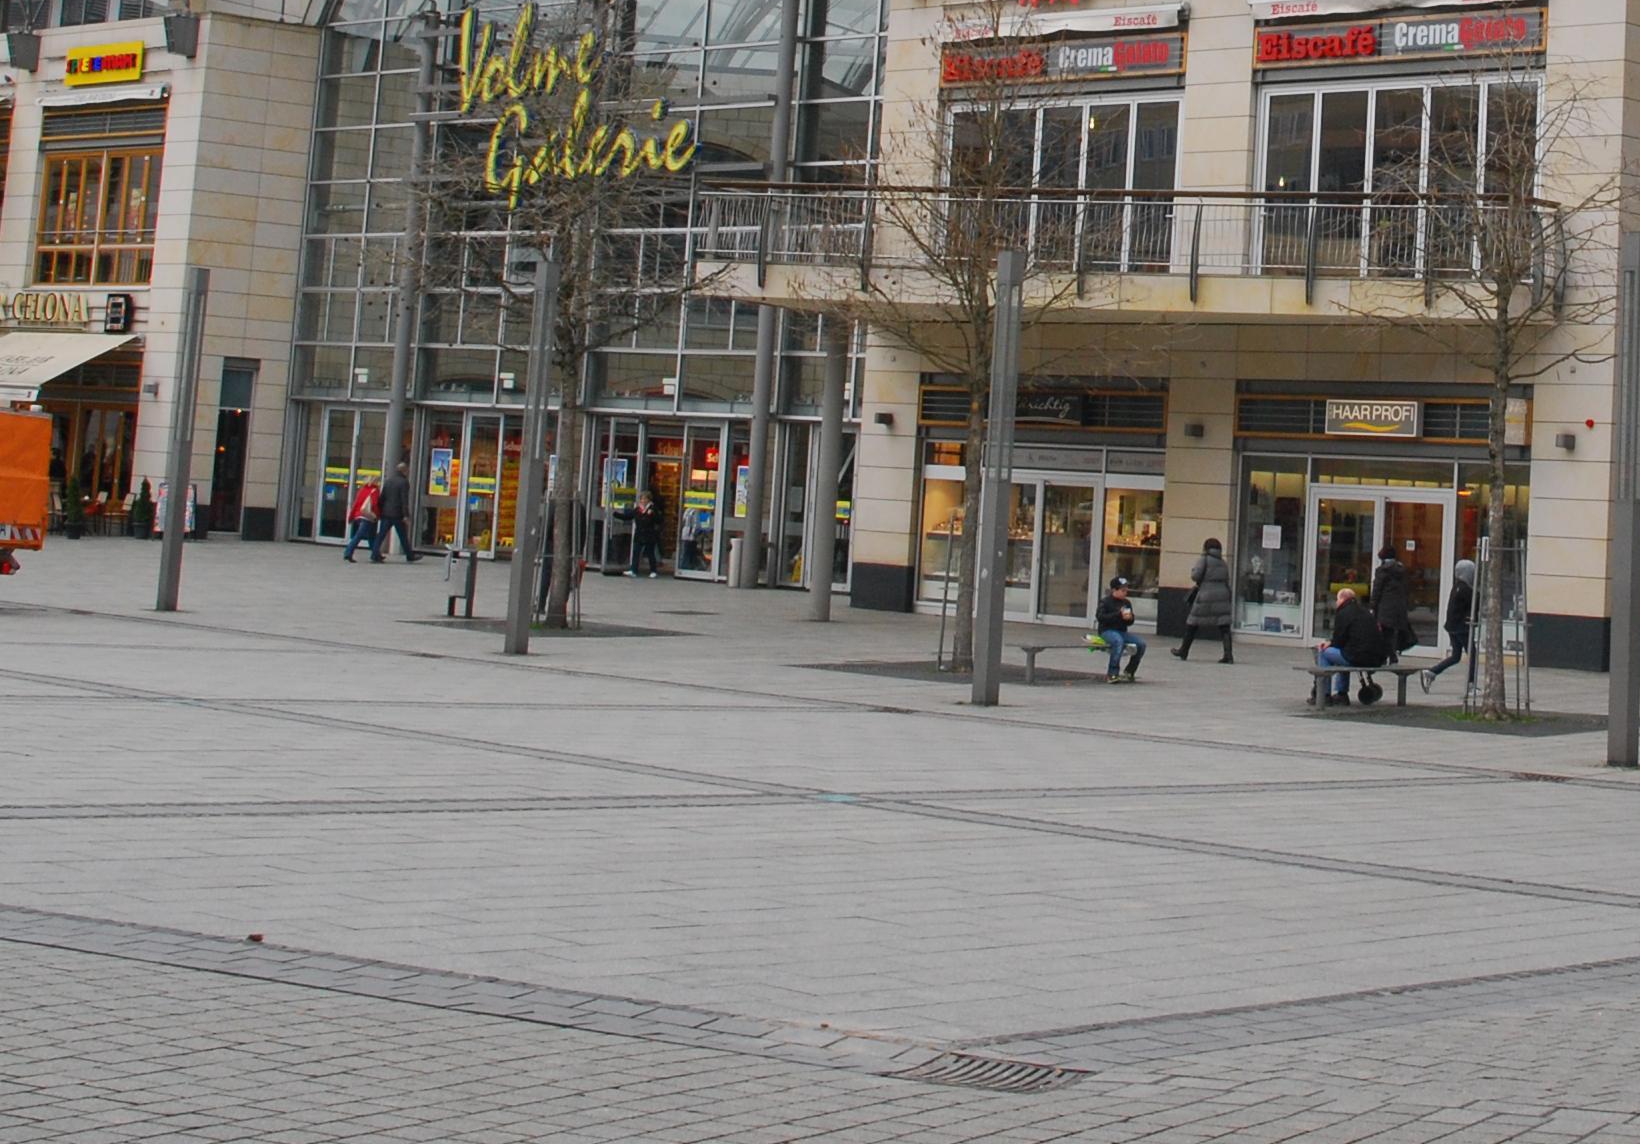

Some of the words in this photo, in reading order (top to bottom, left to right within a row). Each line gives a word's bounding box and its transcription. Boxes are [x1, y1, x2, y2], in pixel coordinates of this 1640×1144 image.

[1113, 13, 1159, 27] Eiscafé
[1271, 0, 1318, 15] Eiscafé
[1256, 25, 1377, 62] Eiscafé
[460, 2, 603, 114] Volme
[485, 88, 698, 210] Galerie
[1333, 404, 1371, 420] HAAR
[1372, 405, 1414, 421] PROFI
